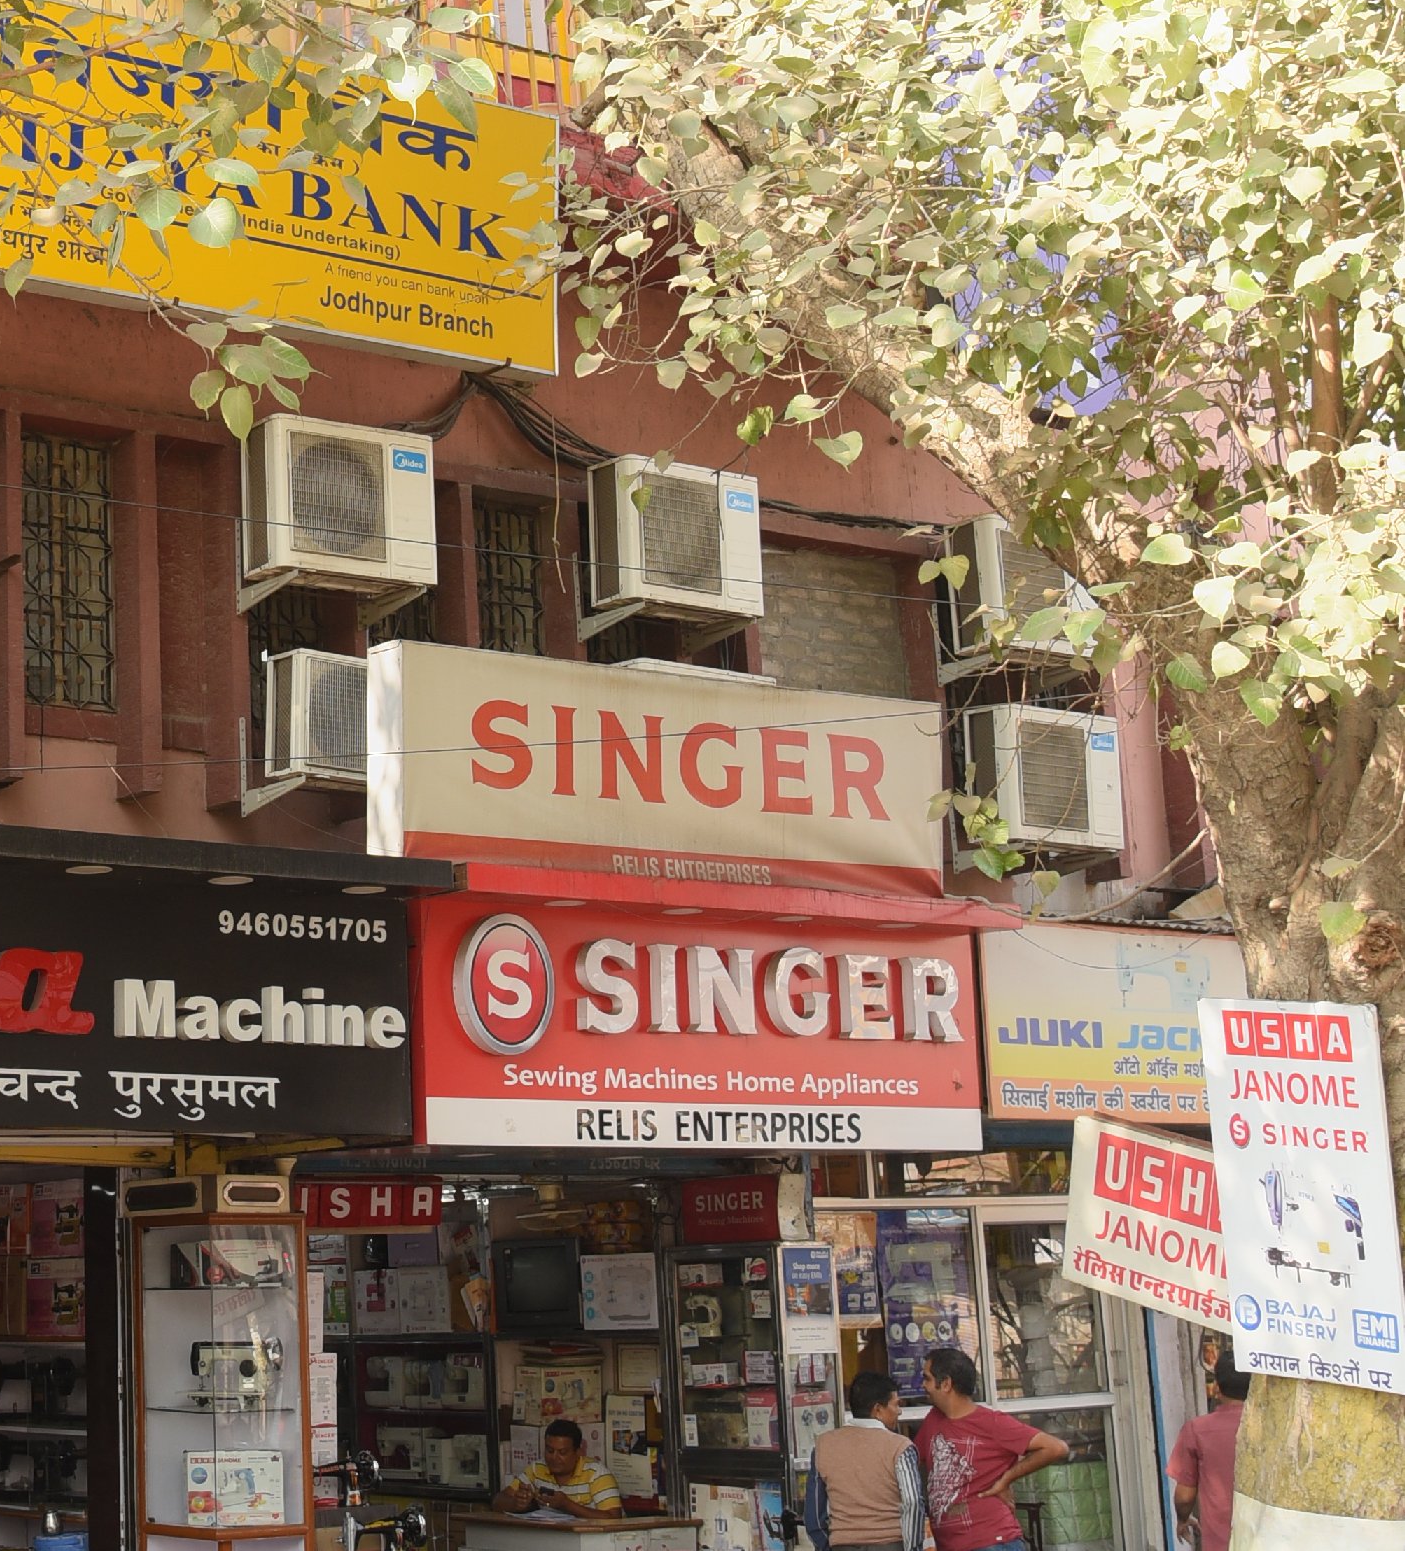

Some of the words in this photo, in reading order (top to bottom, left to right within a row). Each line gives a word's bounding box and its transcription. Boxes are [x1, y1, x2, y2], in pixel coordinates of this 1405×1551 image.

[287, 169, 508, 262] BANK
[291, 223, 401, 260] Undertaking)
[325, 261, 334, 275] A
[337, 263, 372, 283] friend
[376, 273, 398, 289] you
[401, 277, 423, 292] can
[427, 276, 455, 299] bank
[320, 285, 412, 323] Jodhpur
[420, 303, 494, 339] Branch
[400, 457, 424, 470] Midea
[470, 698, 892, 822] SINGER
[612, 853, 661, 880] RELIS
[664, 857, 772, 887] ENTREPRISES
[218, 909, 389, 945] 9460551705
[574, 938, 966, 1045] SINGER
[113, 979, 407, 1050] Machine
[997, 1016, 1104, 1049] JUKI
[1229, 1017, 1348, 1056] USHA
[107, 1071, 281, 1122] पुरसुमल
[502, 1062, 598, 1096] Sewing
[603, 1068, 719, 1095] Machines
[726, 1071, 795, 1095] Home
[800, 1072, 920, 1101] Appliances
[1001, 1081, 1050, 1111] सिलाई
[1054, 1084, 1097, 1110] मशीन
[1103, 1083, 1124, 1111] की
[1130, 1086, 1171, 1113] खरीद
[1177, 1094, 1197, 1113] पर
[1229, 1068, 1360, 1109] JANOME
[575, 1108, 659, 1143] RELIS
[675, 1109, 862, 1145] ENTERPRISES
[1262, 1123, 1369, 1154] SINGER
[1104, 1145, 1207, 1217] USH
[301, 1186, 433, 1218] SHA
[695, 1190, 764, 1213] SINGER
[1095, 1210, 1228, 1280] JANOM
[1074, 1246, 1127, 1286] रेलिस
[1266, 1299, 1337, 1323] BAJAJ
[1267, 1317, 1338, 1342] FINSERV
[1356, 1312, 1395, 1340] EMI
[1357, 1337, 1398, 1350] FINANCE
[1249, 1351, 1301, 1375] आसान
[1308, 1353, 1361, 1385] किश्तों
[1368, 1369, 1393, 1389] पर
